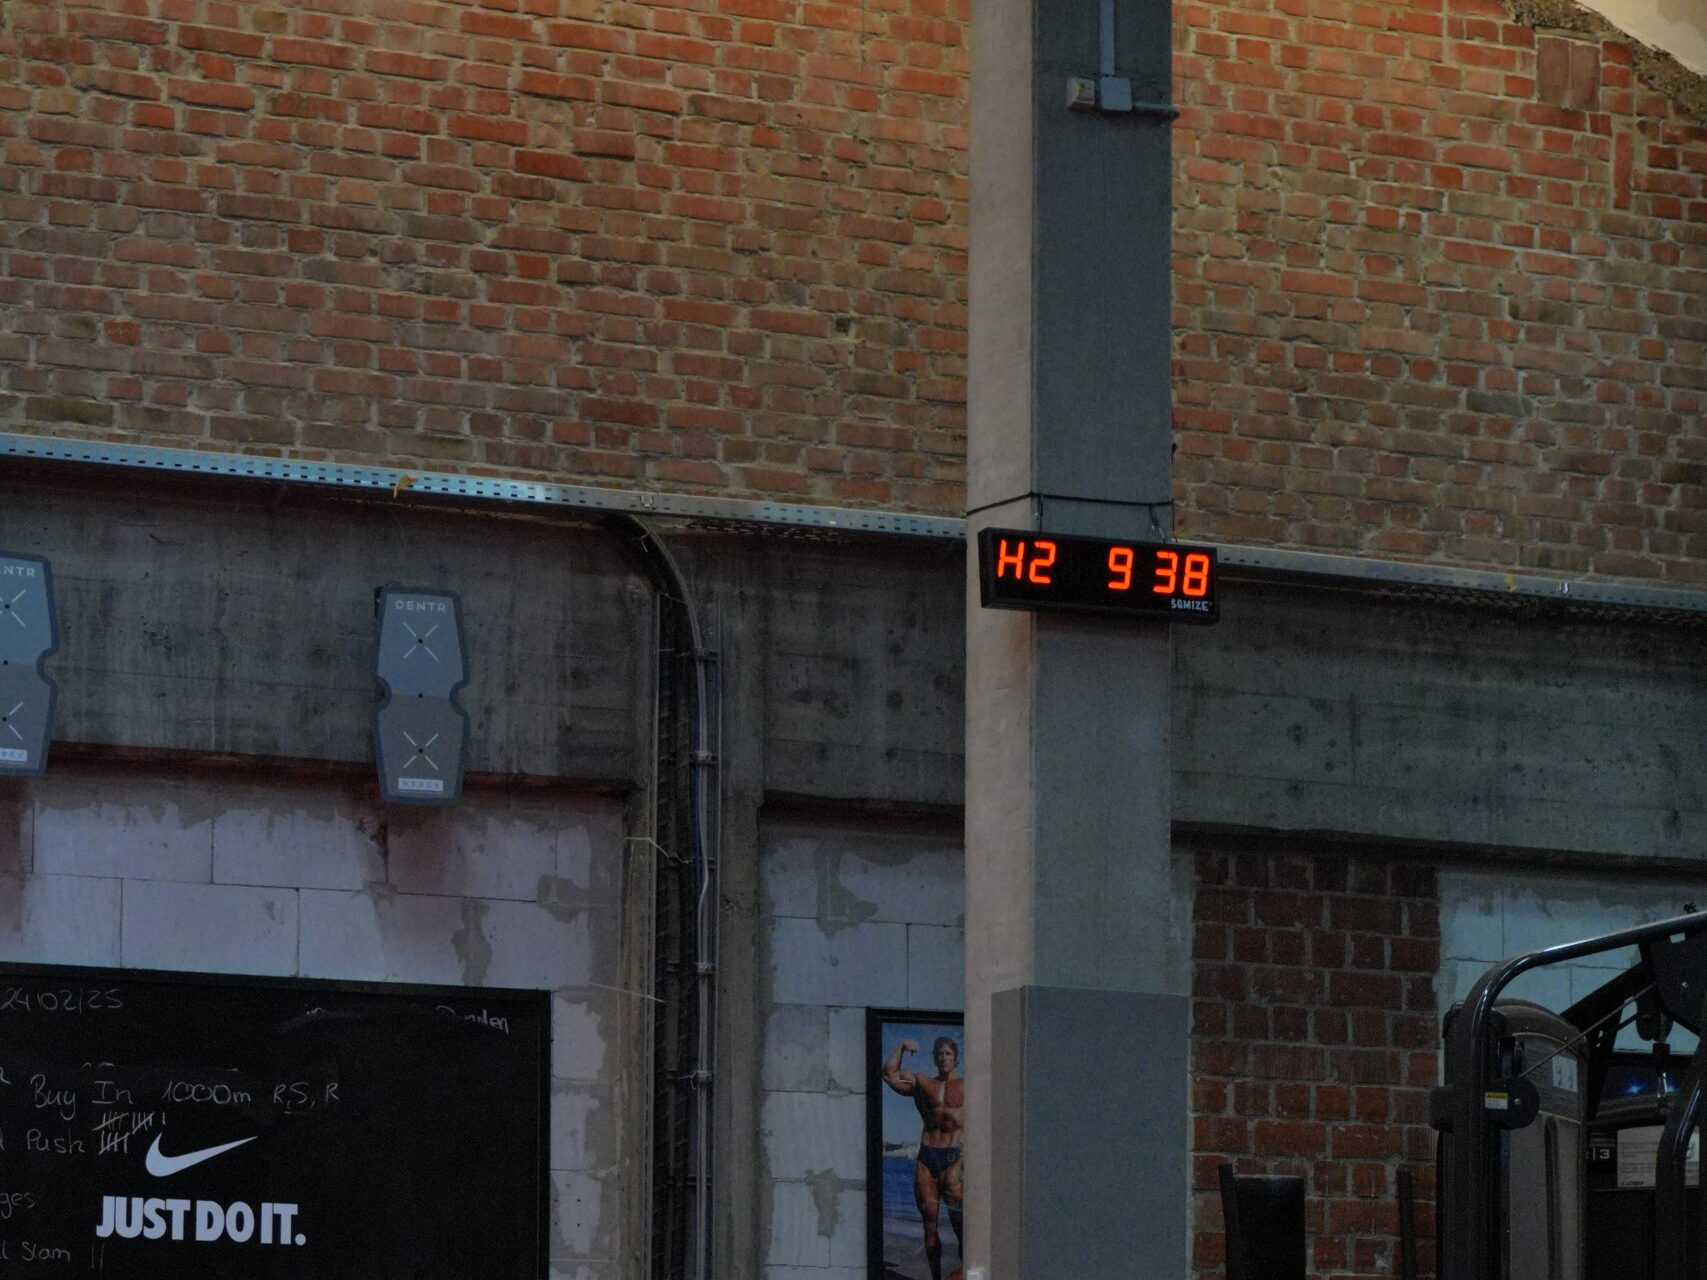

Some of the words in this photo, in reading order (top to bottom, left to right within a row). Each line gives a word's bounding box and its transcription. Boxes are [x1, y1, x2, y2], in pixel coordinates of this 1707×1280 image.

[1107, 546, 1134, 590] 9
[1152, 550, 1210, 597] 38
[30, 1073, 76, 1121] Buy
[161, 1081, 251, 1105] 1000m
[26, 1128, 85, 1155] Push
[96, 1195, 191, 1241] JUST
[195, 1199, 255, 1243] DO
[260, 1202, 307, 1247] IT.
[21, 1240, 71, 1263] Slam
